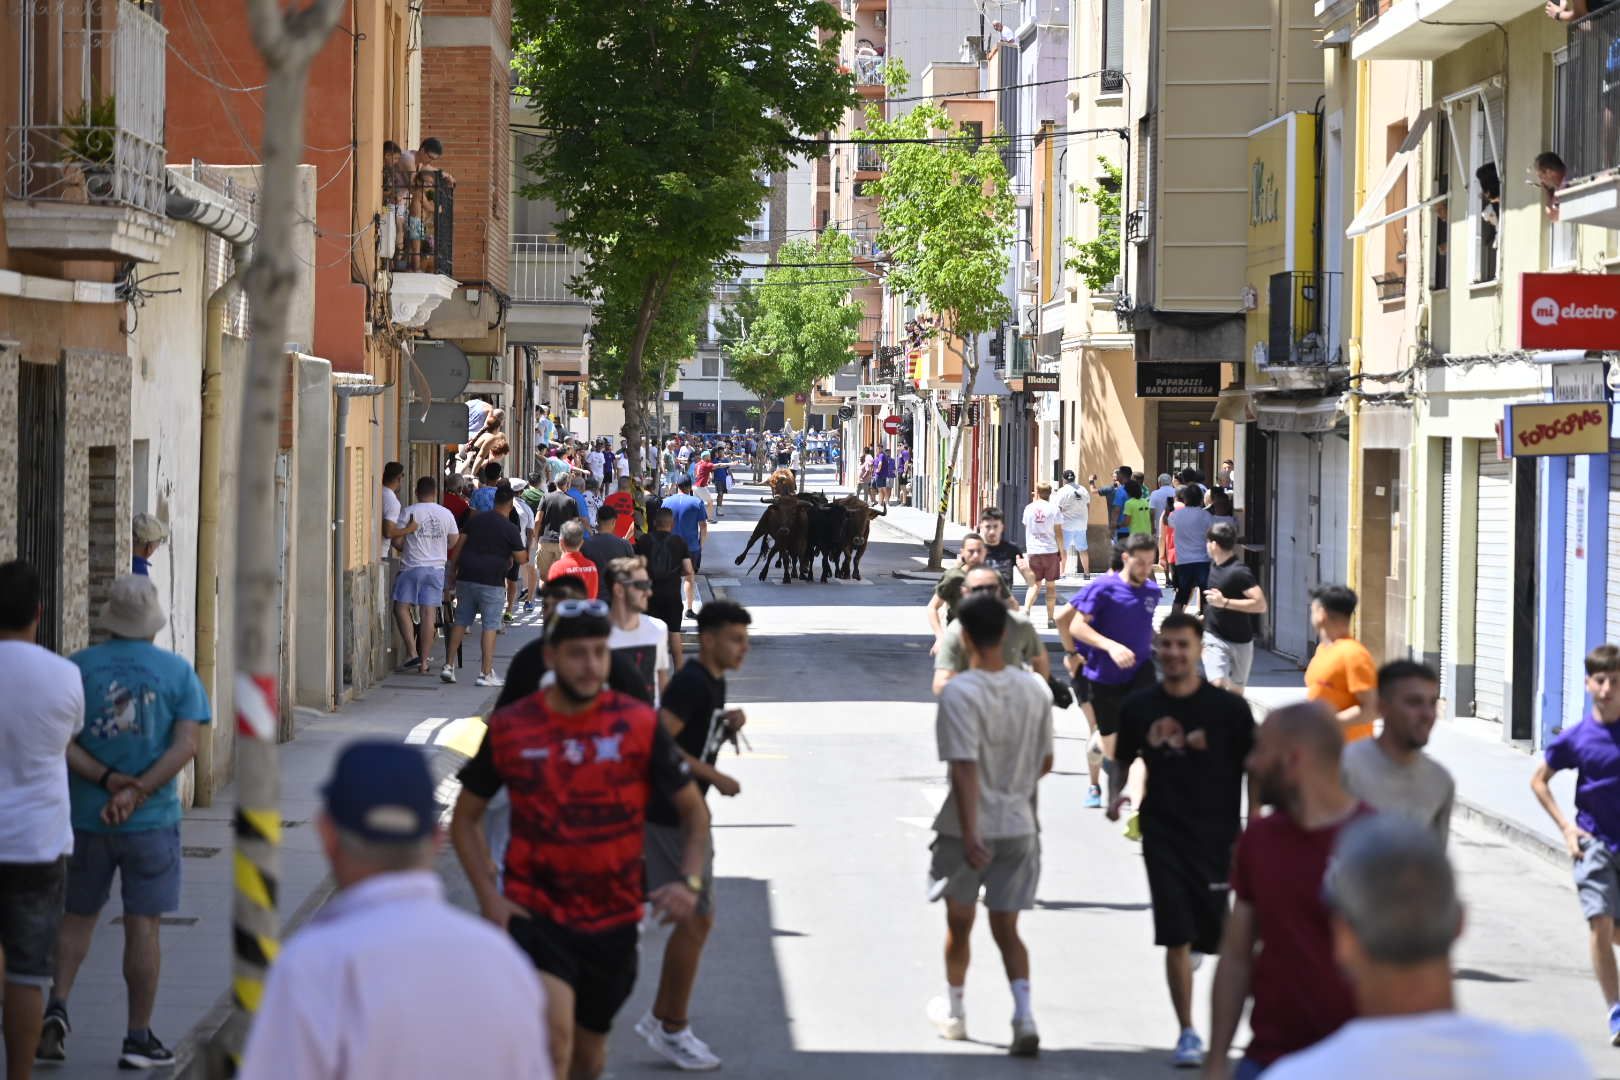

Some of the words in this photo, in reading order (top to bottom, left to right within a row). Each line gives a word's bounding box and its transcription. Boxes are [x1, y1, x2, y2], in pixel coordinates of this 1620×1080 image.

[1536, 304, 1554, 317] mi
[1561, 302, 1617, 319] electro
[1027, 375, 1057, 384] Mahou
[1155, 378, 1202, 386] PAPARAZZI
[1145, 386, 1163, 394] BAR
[1518, 409, 1602, 447] FOTOCOPIAS
